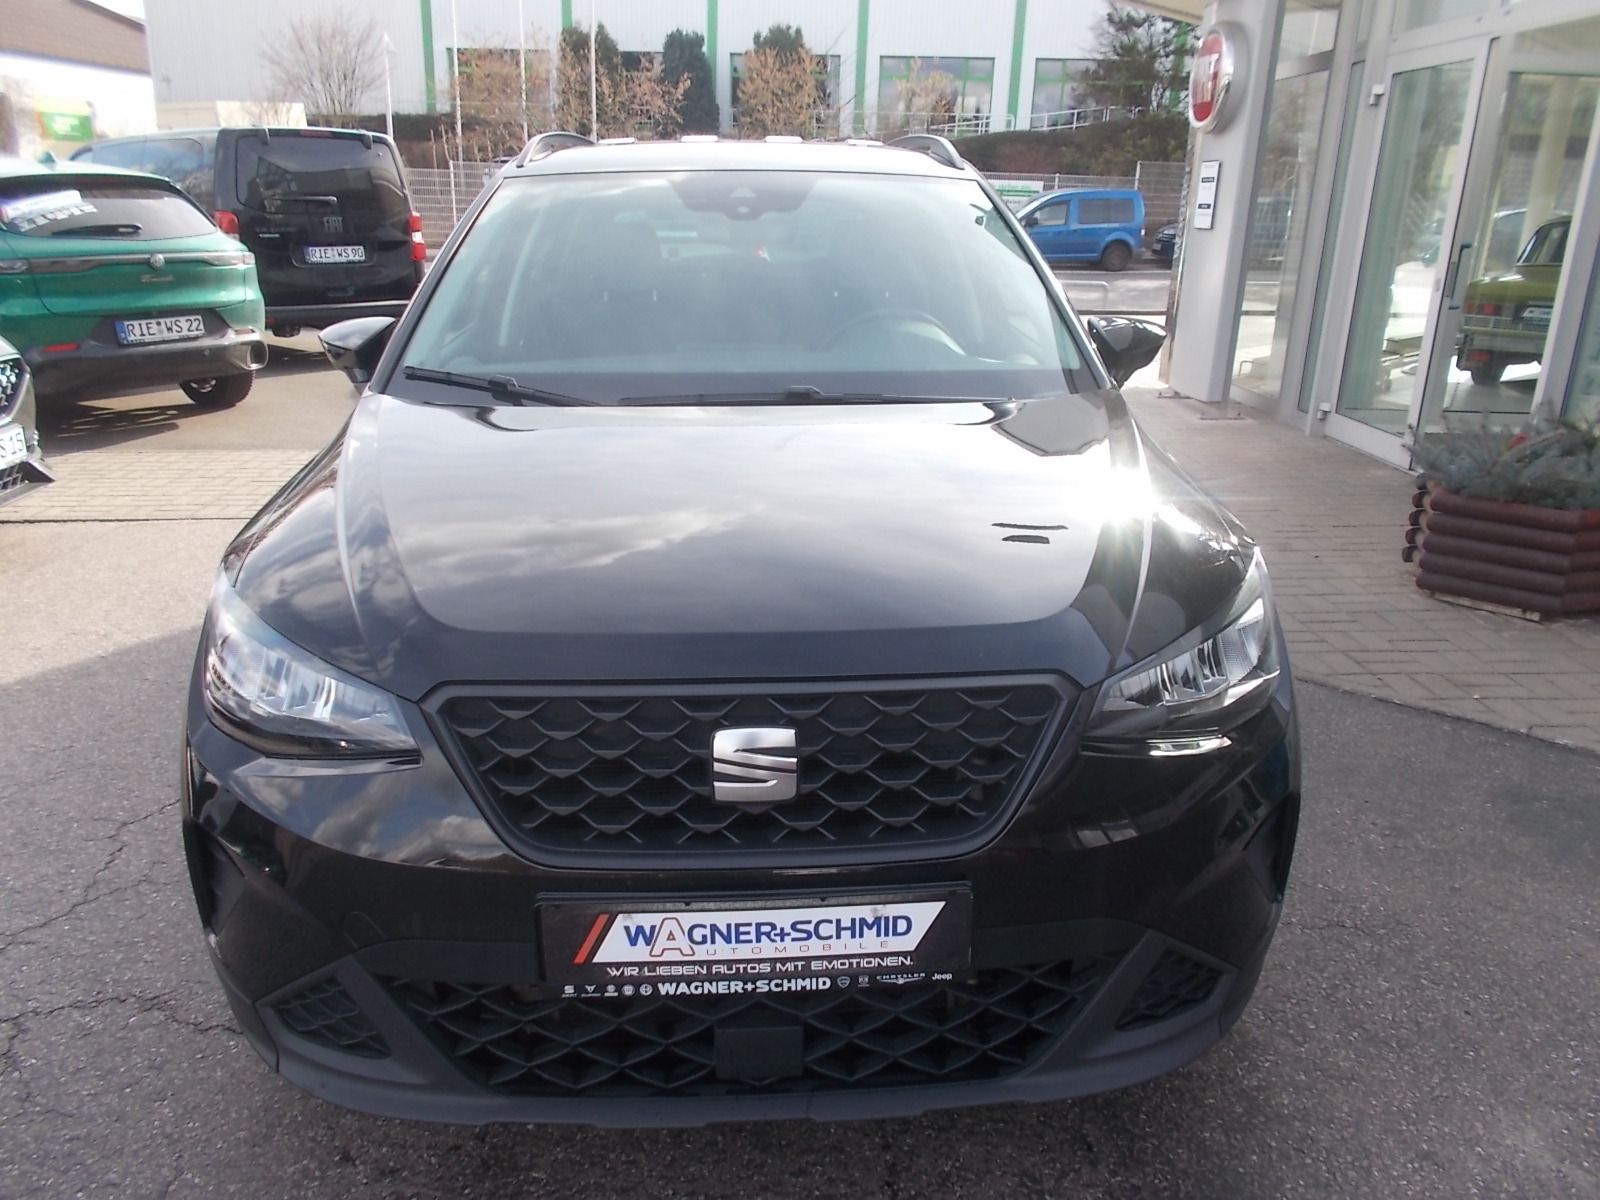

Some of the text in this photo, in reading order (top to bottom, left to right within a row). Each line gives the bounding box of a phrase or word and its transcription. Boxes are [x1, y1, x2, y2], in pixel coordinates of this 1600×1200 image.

[310, 247, 364, 260] RIE WS 90
[126, 318, 203, 338] RIE WS 22
[624, 914, 913, 957] WAGNER+SCHMID
[606, 955, 914, 977] WIR LIEBEN AUTOS MIT EMOTIONEN.
[657, 976, 832, 996] WAGNER+SCHMID
[932, 972, 953, 981] Jeep
